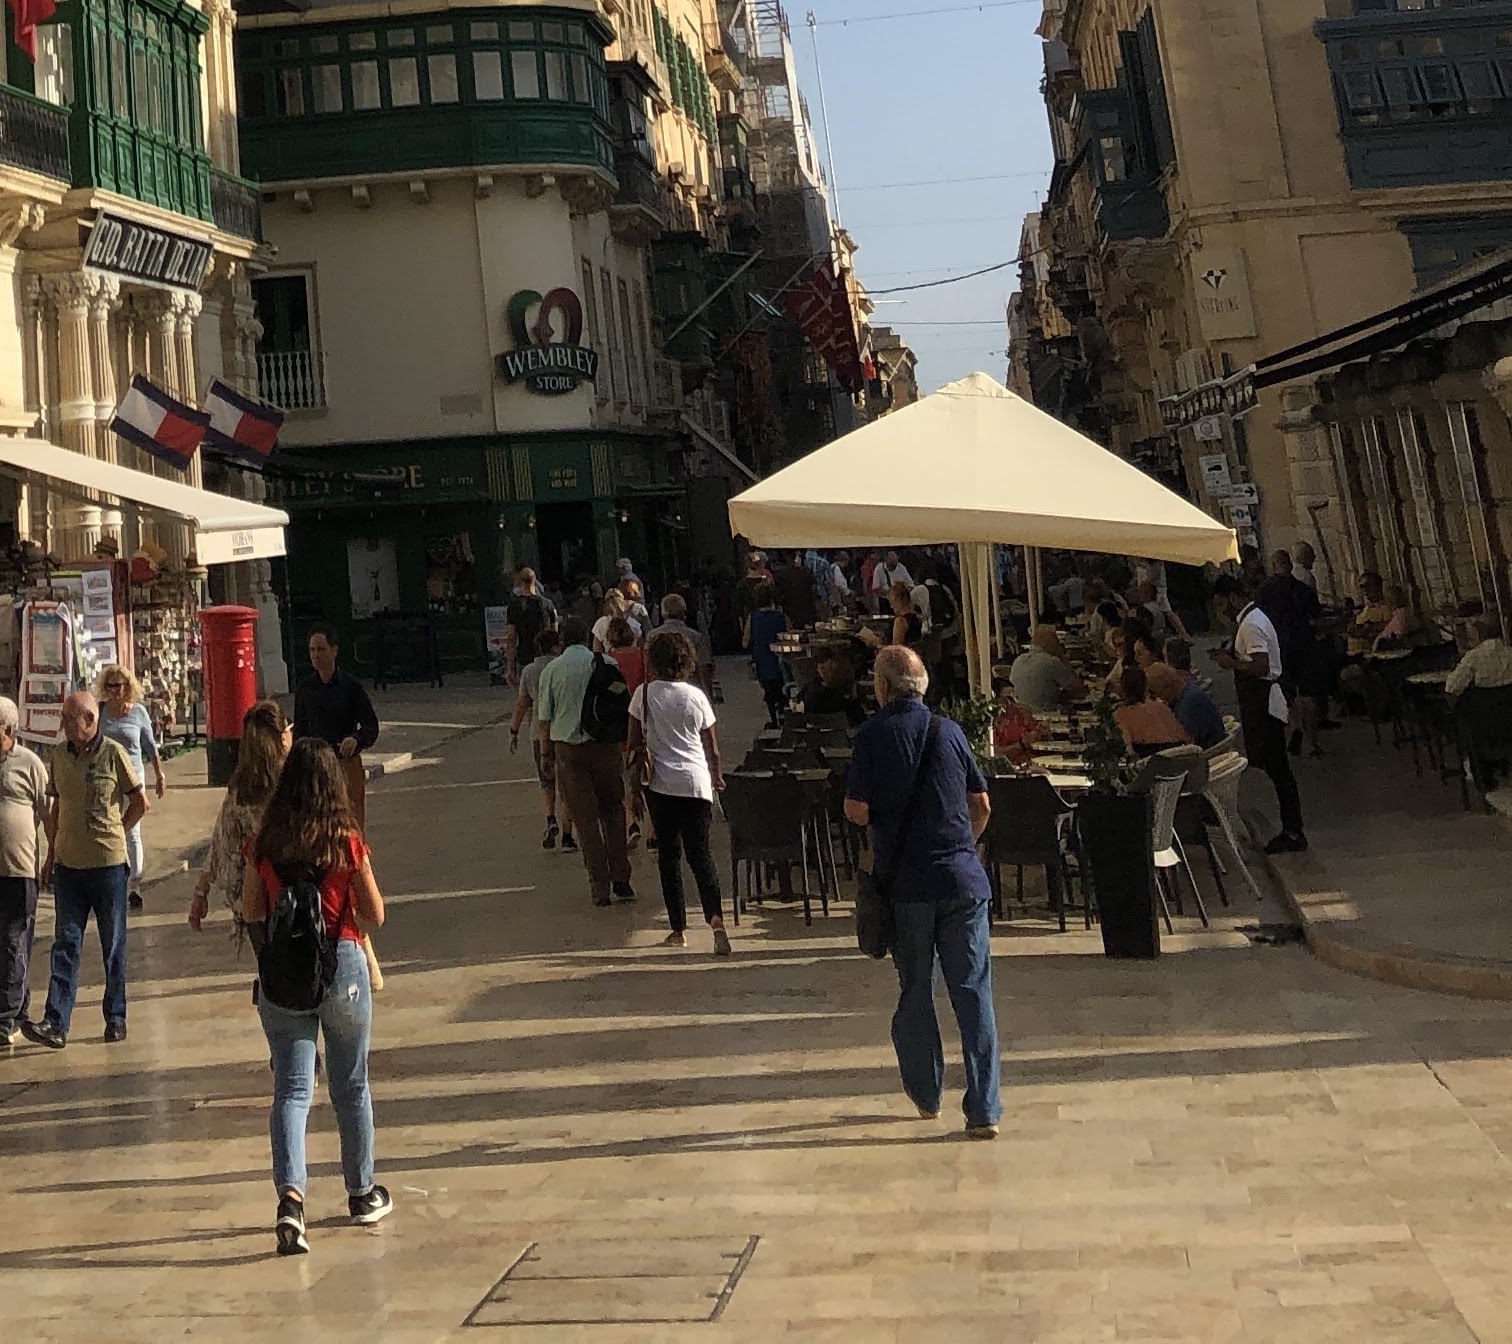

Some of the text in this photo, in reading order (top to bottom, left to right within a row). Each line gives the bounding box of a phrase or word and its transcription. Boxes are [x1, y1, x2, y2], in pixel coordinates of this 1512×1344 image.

[119, 226, 170, 278] BATTA
[506, 348, 594, 377] WEMBLEY
[536, 376, 572, 390] STORE
